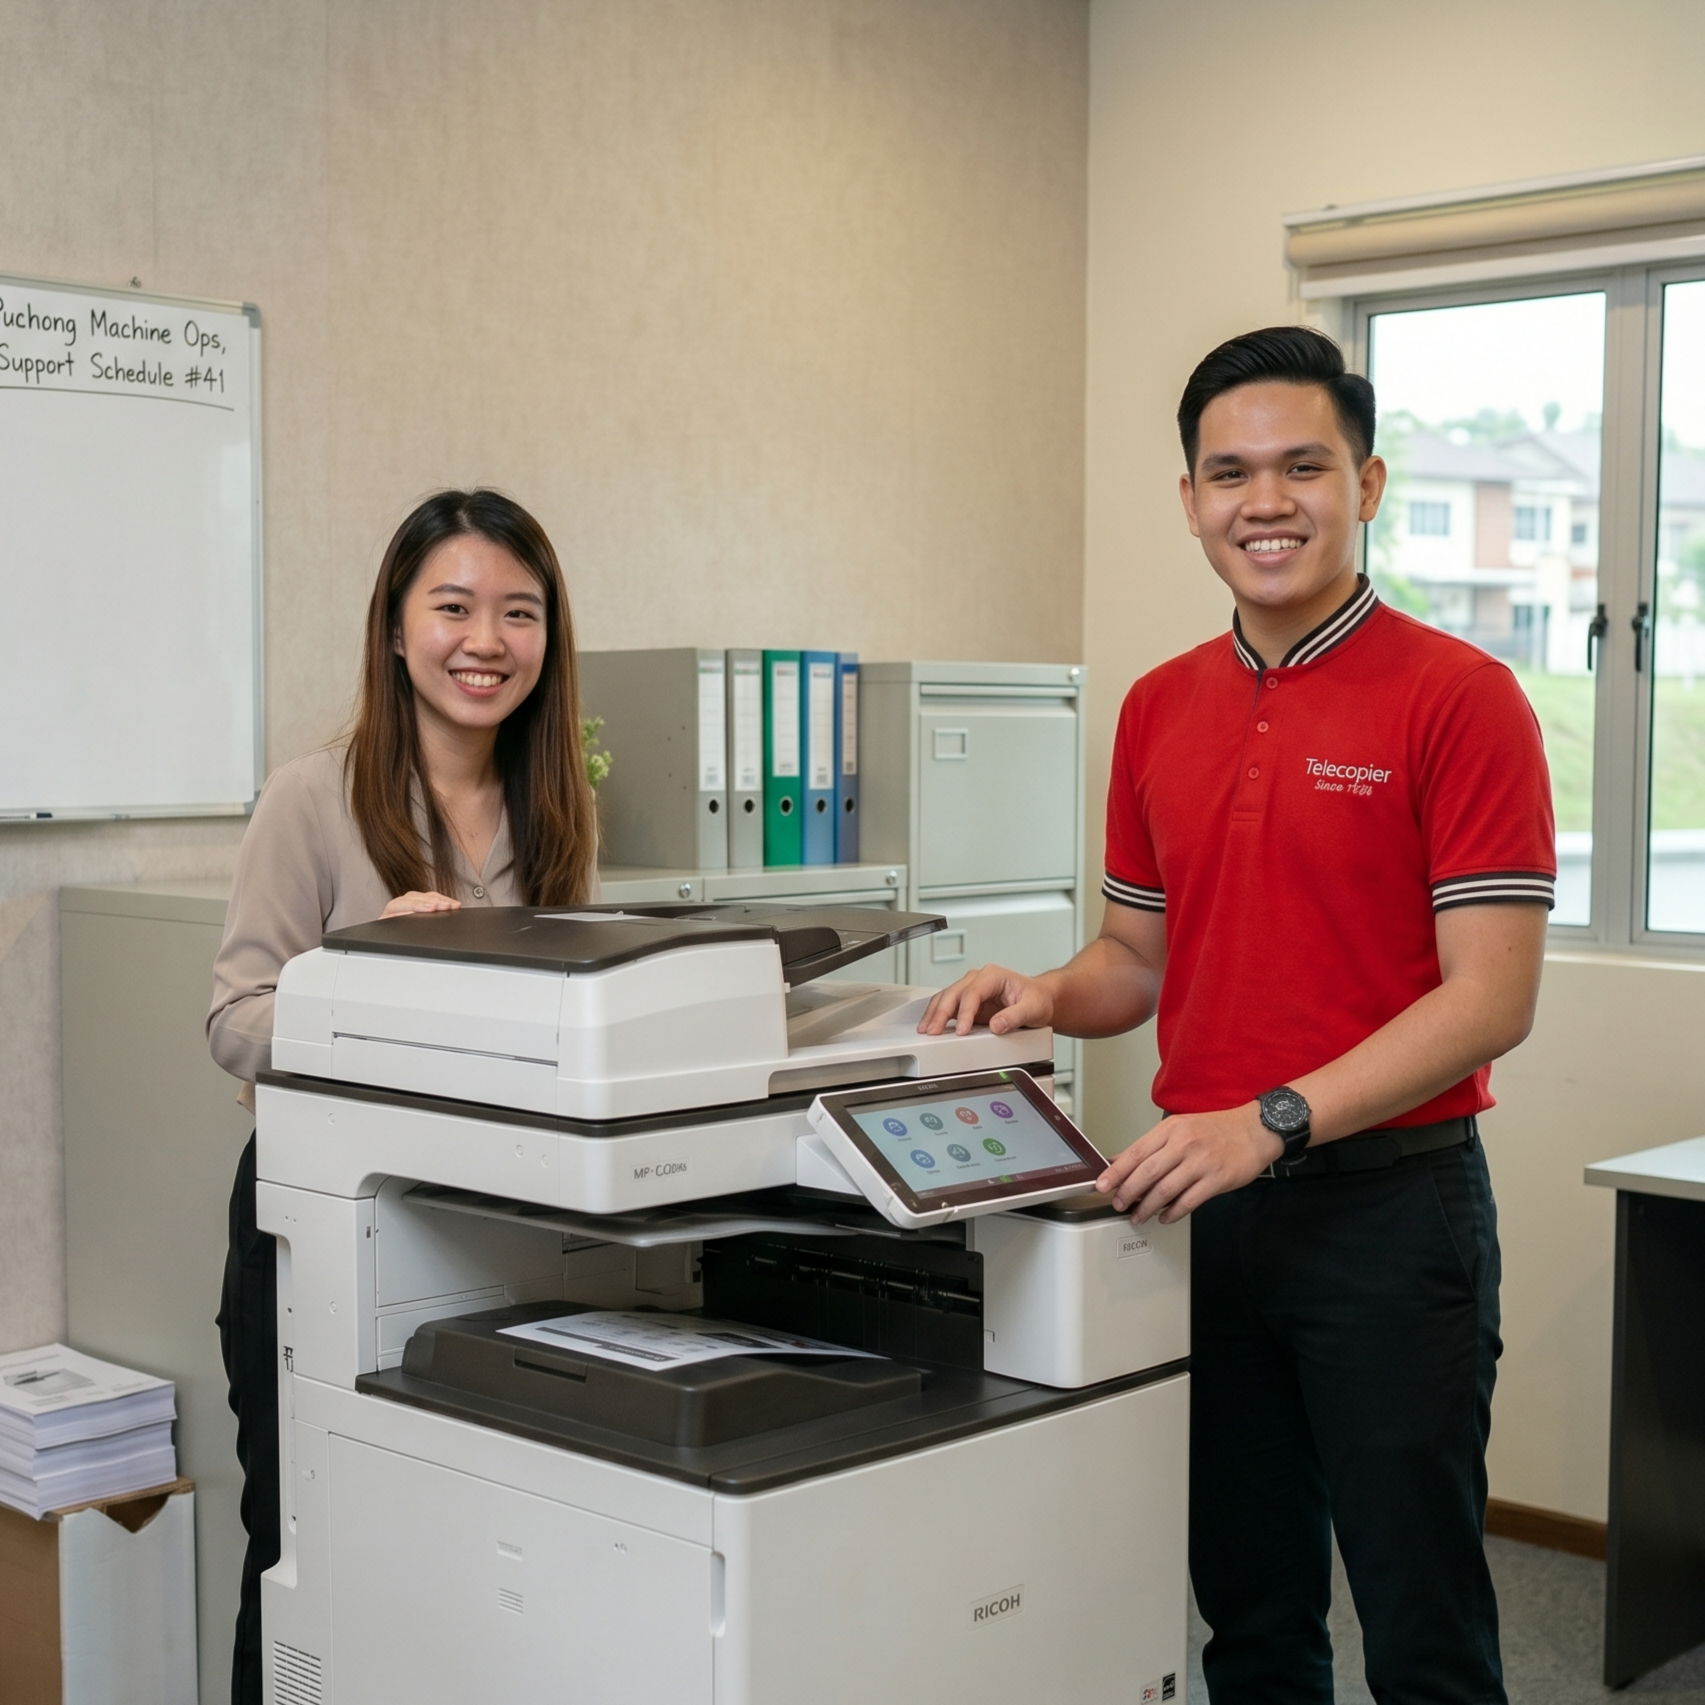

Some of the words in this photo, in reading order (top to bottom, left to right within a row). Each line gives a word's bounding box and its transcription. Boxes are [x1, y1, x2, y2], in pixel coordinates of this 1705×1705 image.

[90, 309, 172, 344] Machine
[184, 320, 226, 357] Ops,
[90, 352, 175, 387] Schedule
[184, 365, 225, 394] #41
[1306, 758, 1392, 783] Telecopier
[1314, 779, 1344, 792] Since
[974, 1593, 1020, 1622] RICOH
